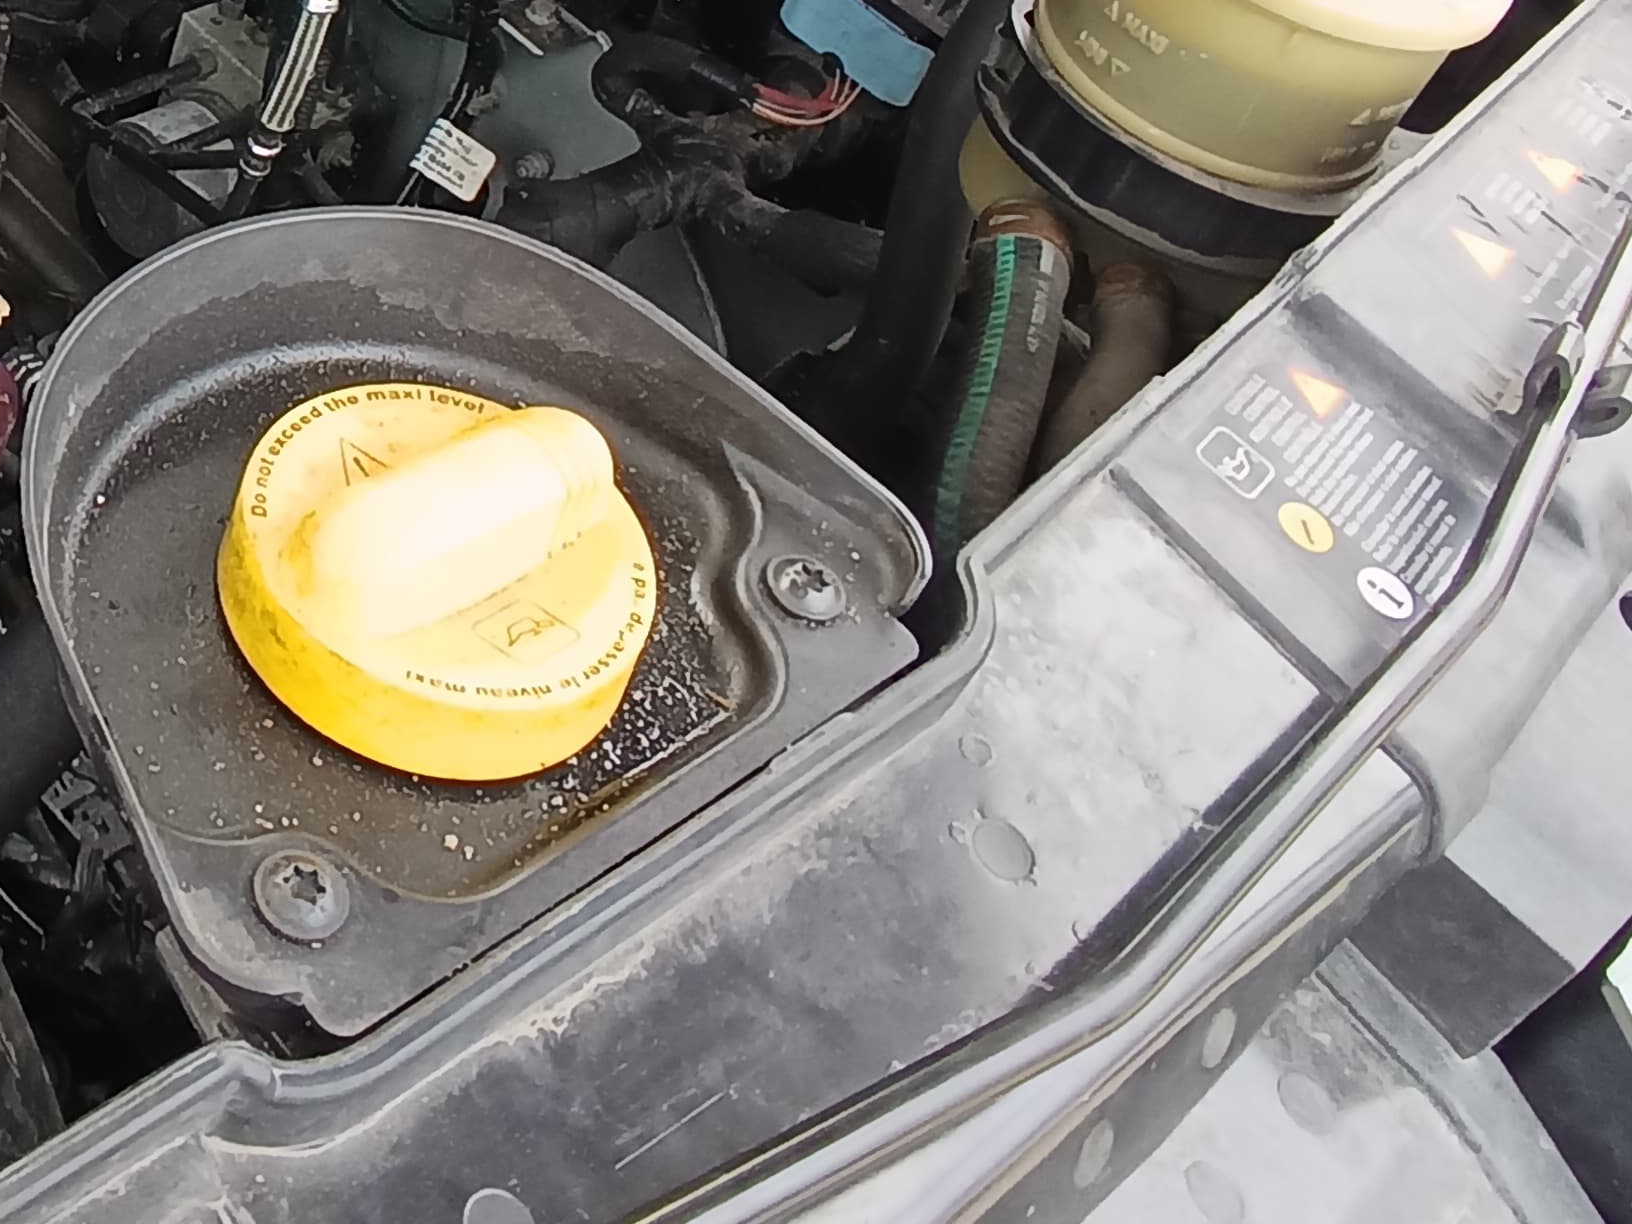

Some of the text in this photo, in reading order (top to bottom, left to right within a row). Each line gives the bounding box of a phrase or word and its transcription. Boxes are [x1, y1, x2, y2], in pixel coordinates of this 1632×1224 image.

[251, 388, 485, 518] Do not exceed the maxi level
